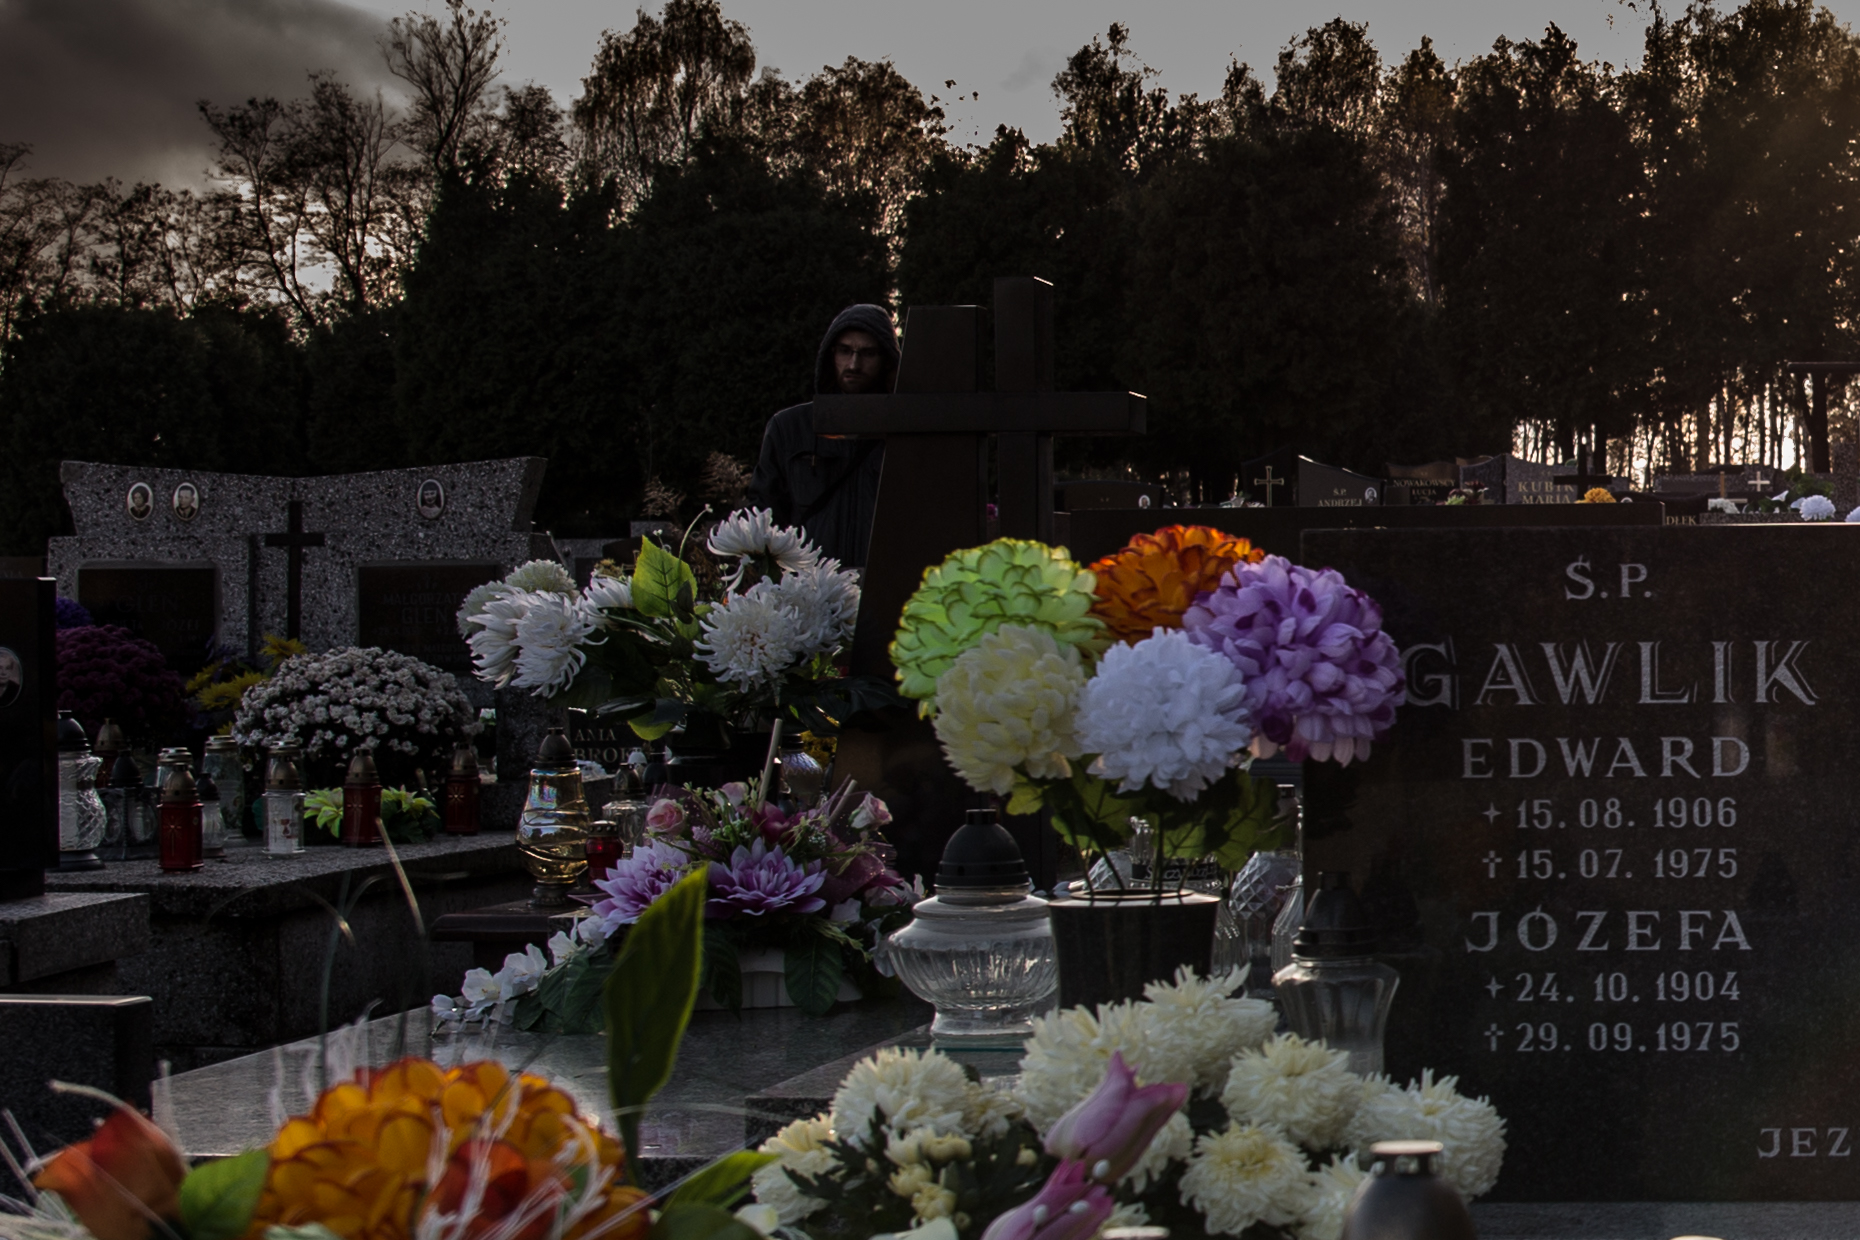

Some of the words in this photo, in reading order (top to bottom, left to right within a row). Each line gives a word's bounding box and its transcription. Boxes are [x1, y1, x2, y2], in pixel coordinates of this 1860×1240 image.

[1317, 499, 1363, 507] ANDRZEJ
[1401, 640, 1820, 708] GAWLIK
[1462, 736, 1751, 779] EDWARD
[1517, 798, 1567, 830] 15.
[1578, 797, 1636, 830] 08.
[1653, 796, 1738, 829] 1906
[1516, 848, 1567, 880] 15.
[1578, 848, 1633, 879] 07.
[1654, 847, 1738, 879] 1975
[1465, 905, 1753, 953] JÓZEFA
[1515, 972, 1575, 1004] 24.
[1593, 971, 1640, 1003] 10.
[1655, 970, 1741, 1003] 1904
